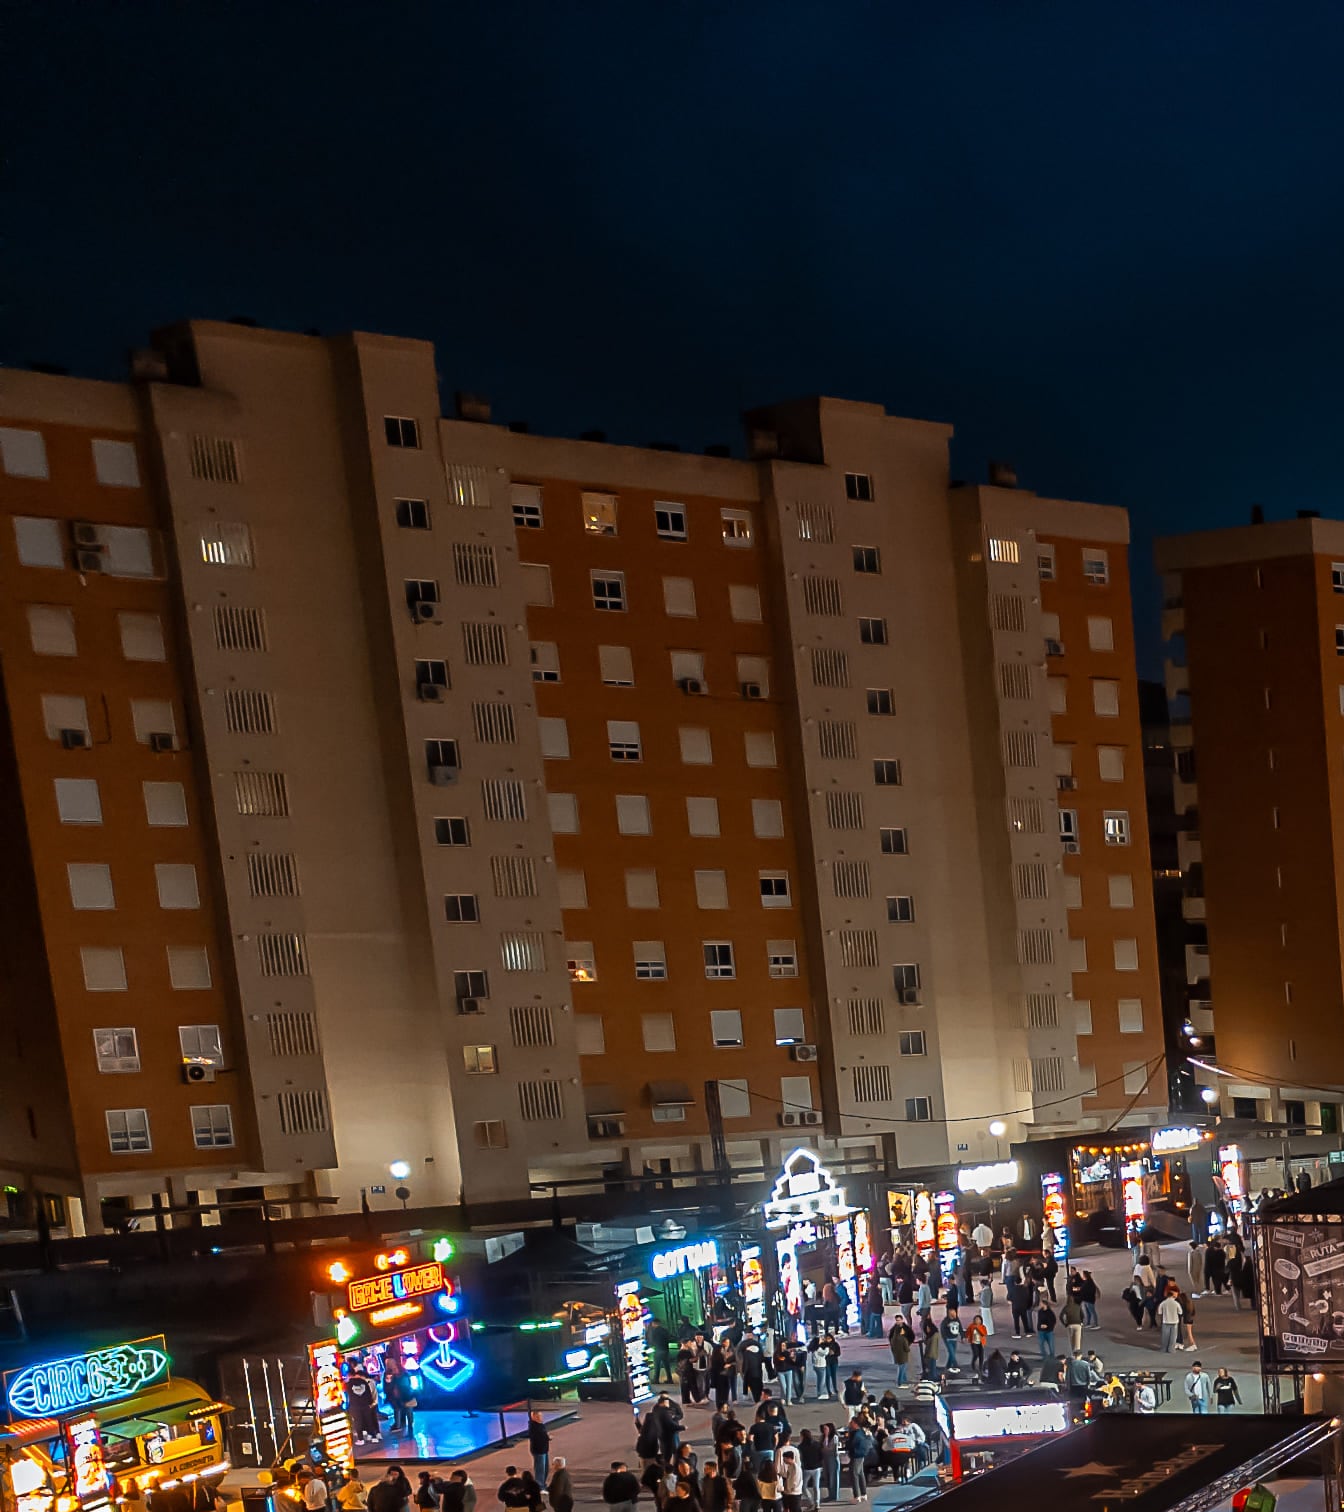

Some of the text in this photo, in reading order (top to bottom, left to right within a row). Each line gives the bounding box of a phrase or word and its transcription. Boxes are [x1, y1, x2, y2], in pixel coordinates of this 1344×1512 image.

[1310, 1244, 1337, 1258] RUTA
[353, 1265, 442, 1308] GAME LOVER
